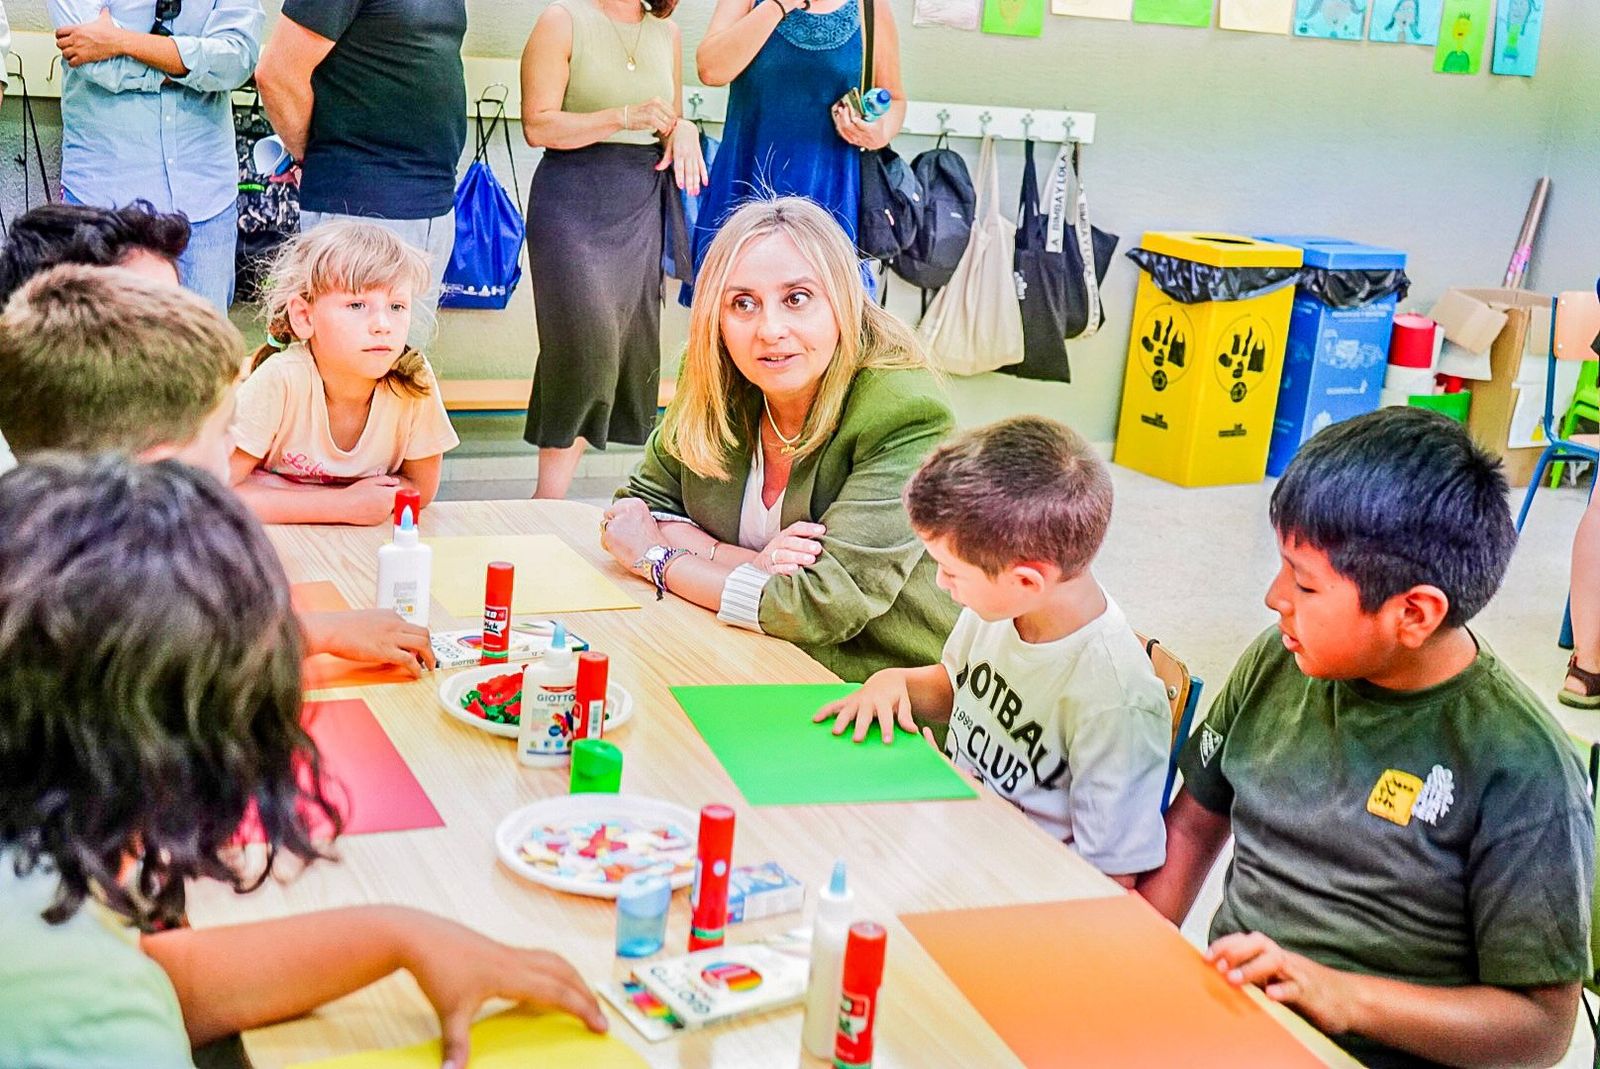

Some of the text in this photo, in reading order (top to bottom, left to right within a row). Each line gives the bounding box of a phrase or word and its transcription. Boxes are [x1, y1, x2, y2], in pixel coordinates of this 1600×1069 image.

[1057, 154, 1068, 184] LOLA
[1052, 195, 1064, 231] BIMBA
[537, 693, 576, 703] GIOTTO
[956, 661, 1069, 791] OTBALL
[966, 725, 1029, 794] CLUB
